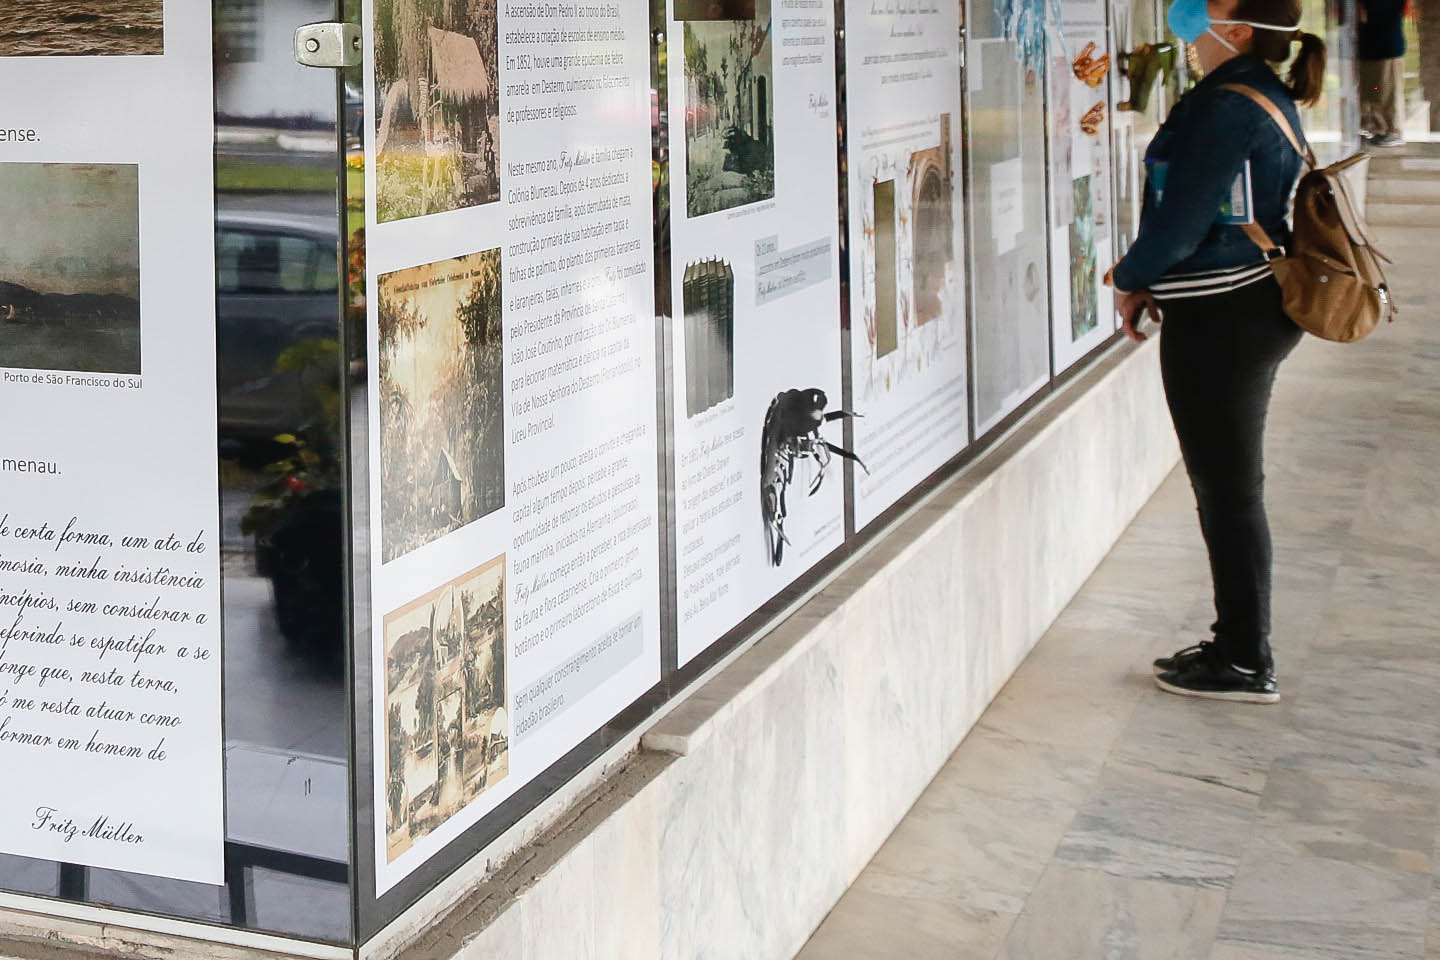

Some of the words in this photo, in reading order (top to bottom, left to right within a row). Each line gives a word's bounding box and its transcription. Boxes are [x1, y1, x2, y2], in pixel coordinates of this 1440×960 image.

[506, 55, 515, 70] Em
[517, 55, 532, 72] 1852,
[534, 53, 549, 68] houve
[552, 57, 562, 67] uma
[508, 162, 524, 176] Neste
[526, 163, 545, 173] mesmo
[547, 159, 558, 171] ano,
[39, 667, 72, 687] que,
[80, 668, 126, 686] nesta
[130, 670, 177, 694] terra,
[32, 807, 79, 842] Fritz
[82, 816, 144, 844] Müller
